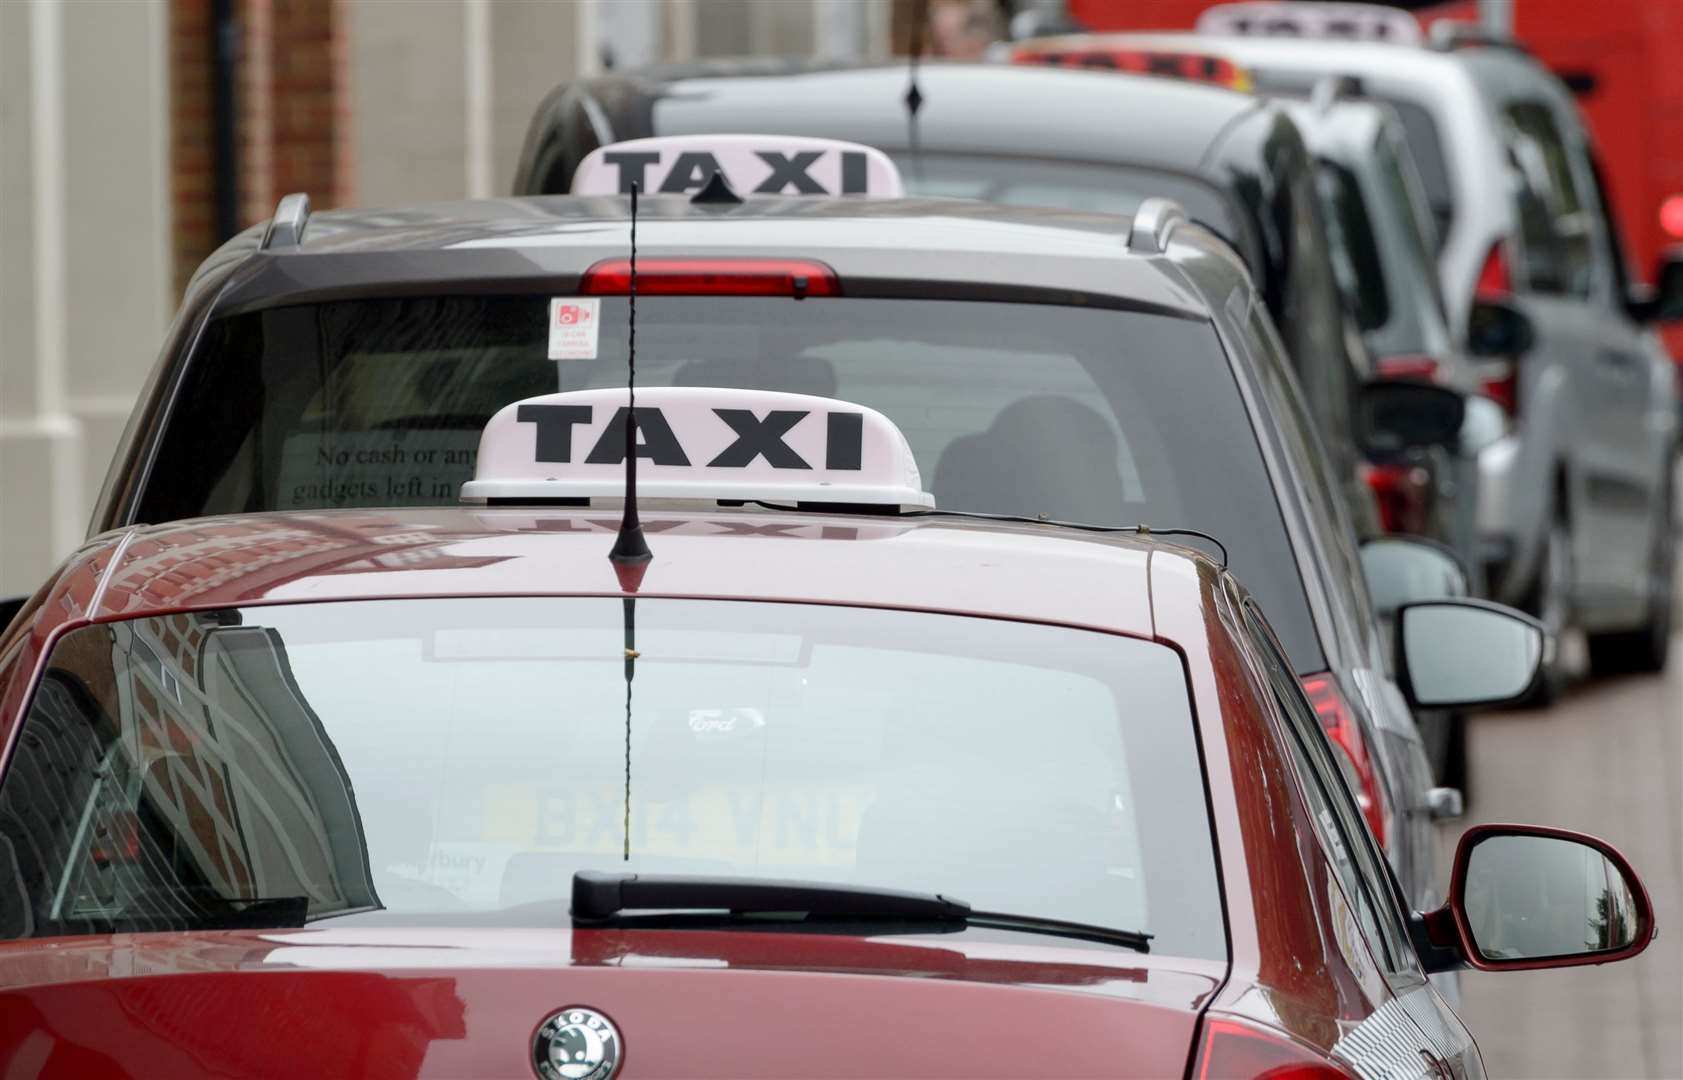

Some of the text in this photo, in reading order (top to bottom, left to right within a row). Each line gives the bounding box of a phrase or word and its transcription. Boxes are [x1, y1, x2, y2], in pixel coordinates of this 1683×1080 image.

[603, 151, 868, 195] TAXI
[316, 447, 349, 465] No
[356, 444, 405, 465] cash
[414, 451, 435, 465] or
[517, 404, 863, 471] TAXI
[293, 477, 451, 504] gadgets left in
[689, 709, 737, 732] Ford
[535, 785, 699, 849] BX14
